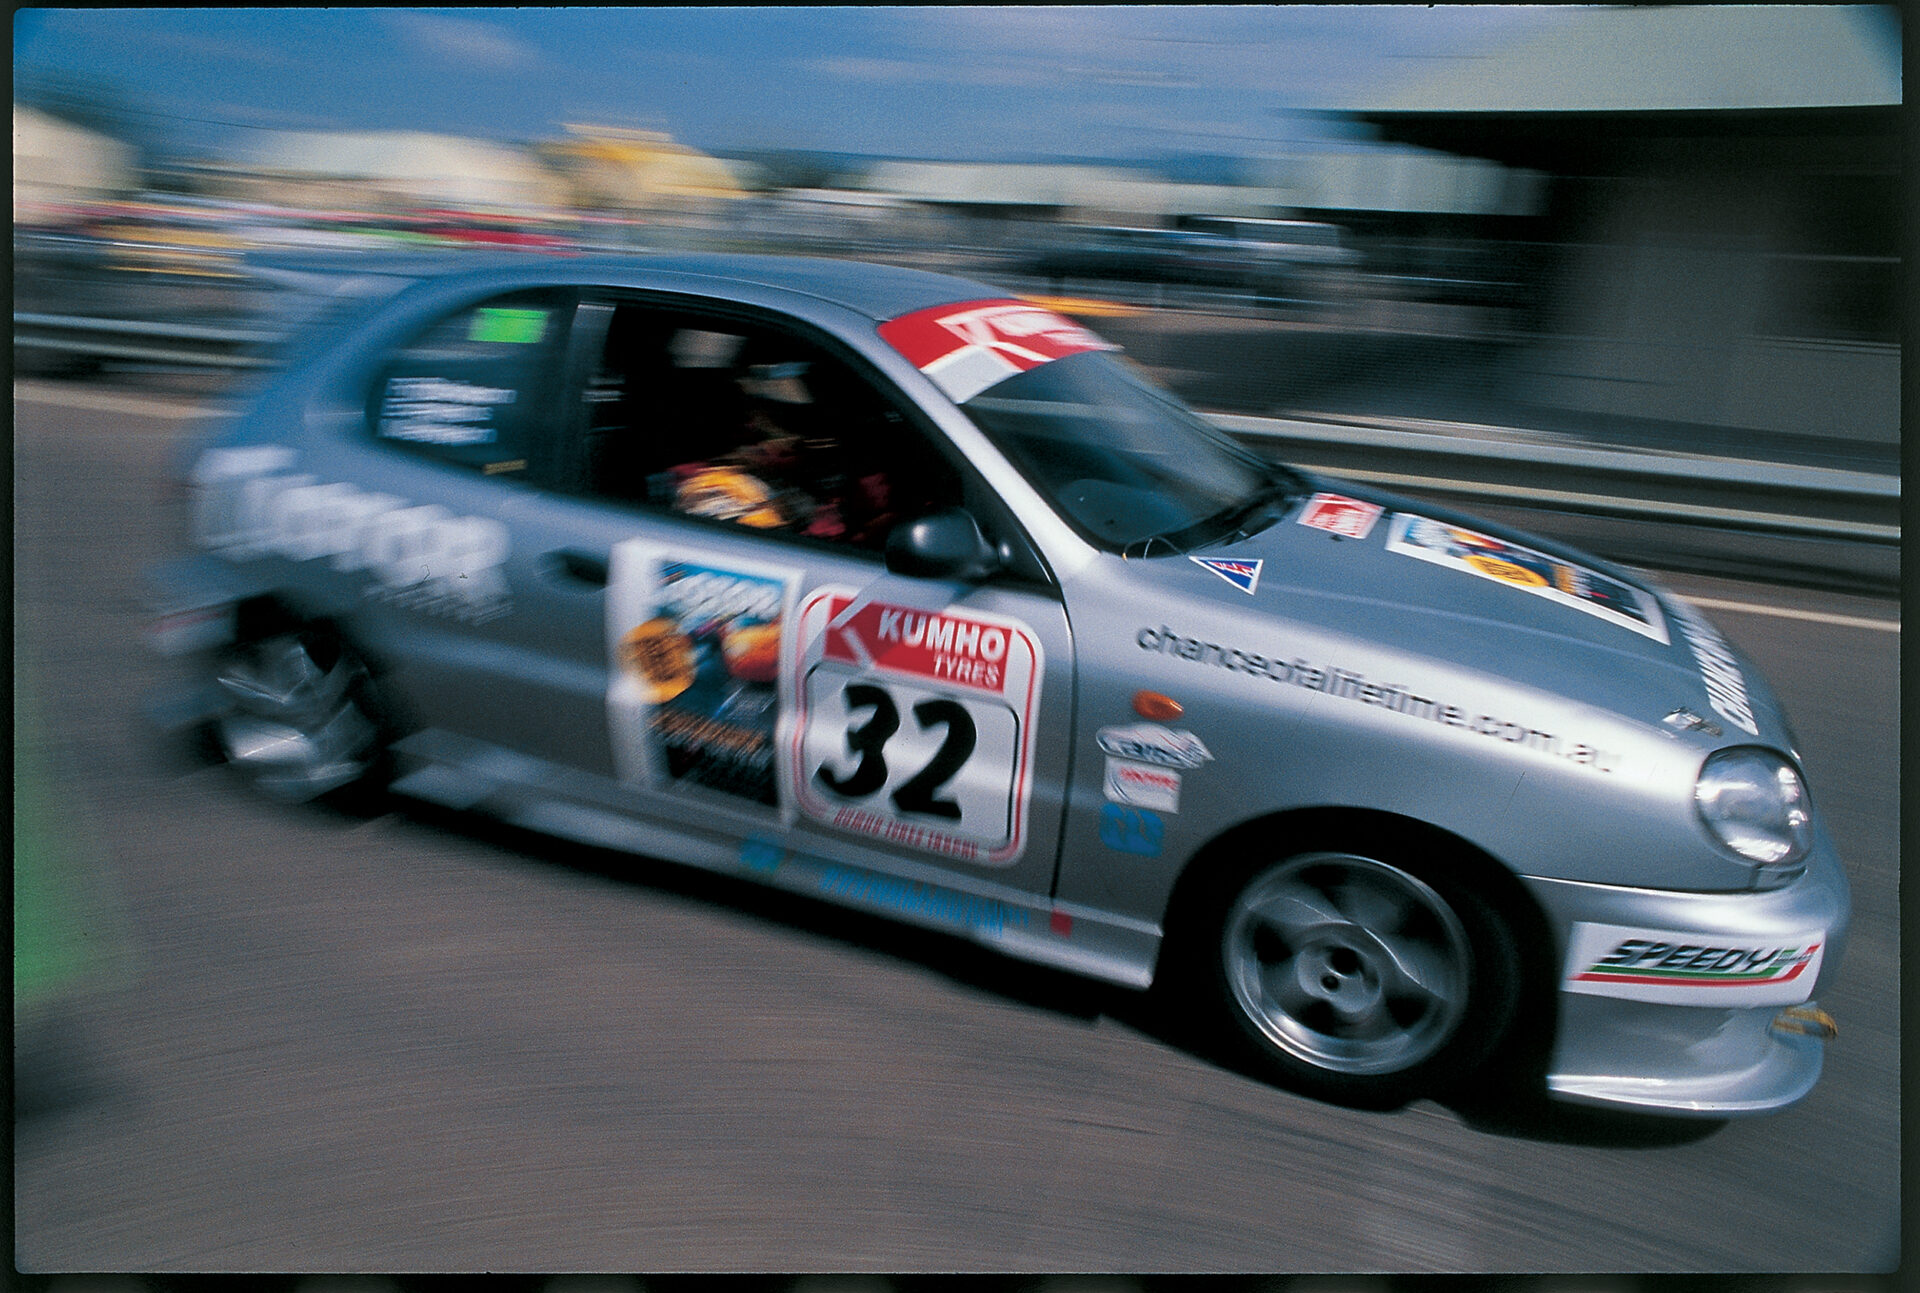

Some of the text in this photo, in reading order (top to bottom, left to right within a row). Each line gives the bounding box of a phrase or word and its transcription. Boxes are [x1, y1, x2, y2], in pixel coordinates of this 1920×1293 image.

[877, 607, 1006, 663] KUMHO
[934, 652, 1000, 689] TYRES
[1136, 624, 1618, 773] chanceofalifetime.com.au
[817, 683, 977, 822] 32
[1600, 938, 1782, 973] SPEEDY
